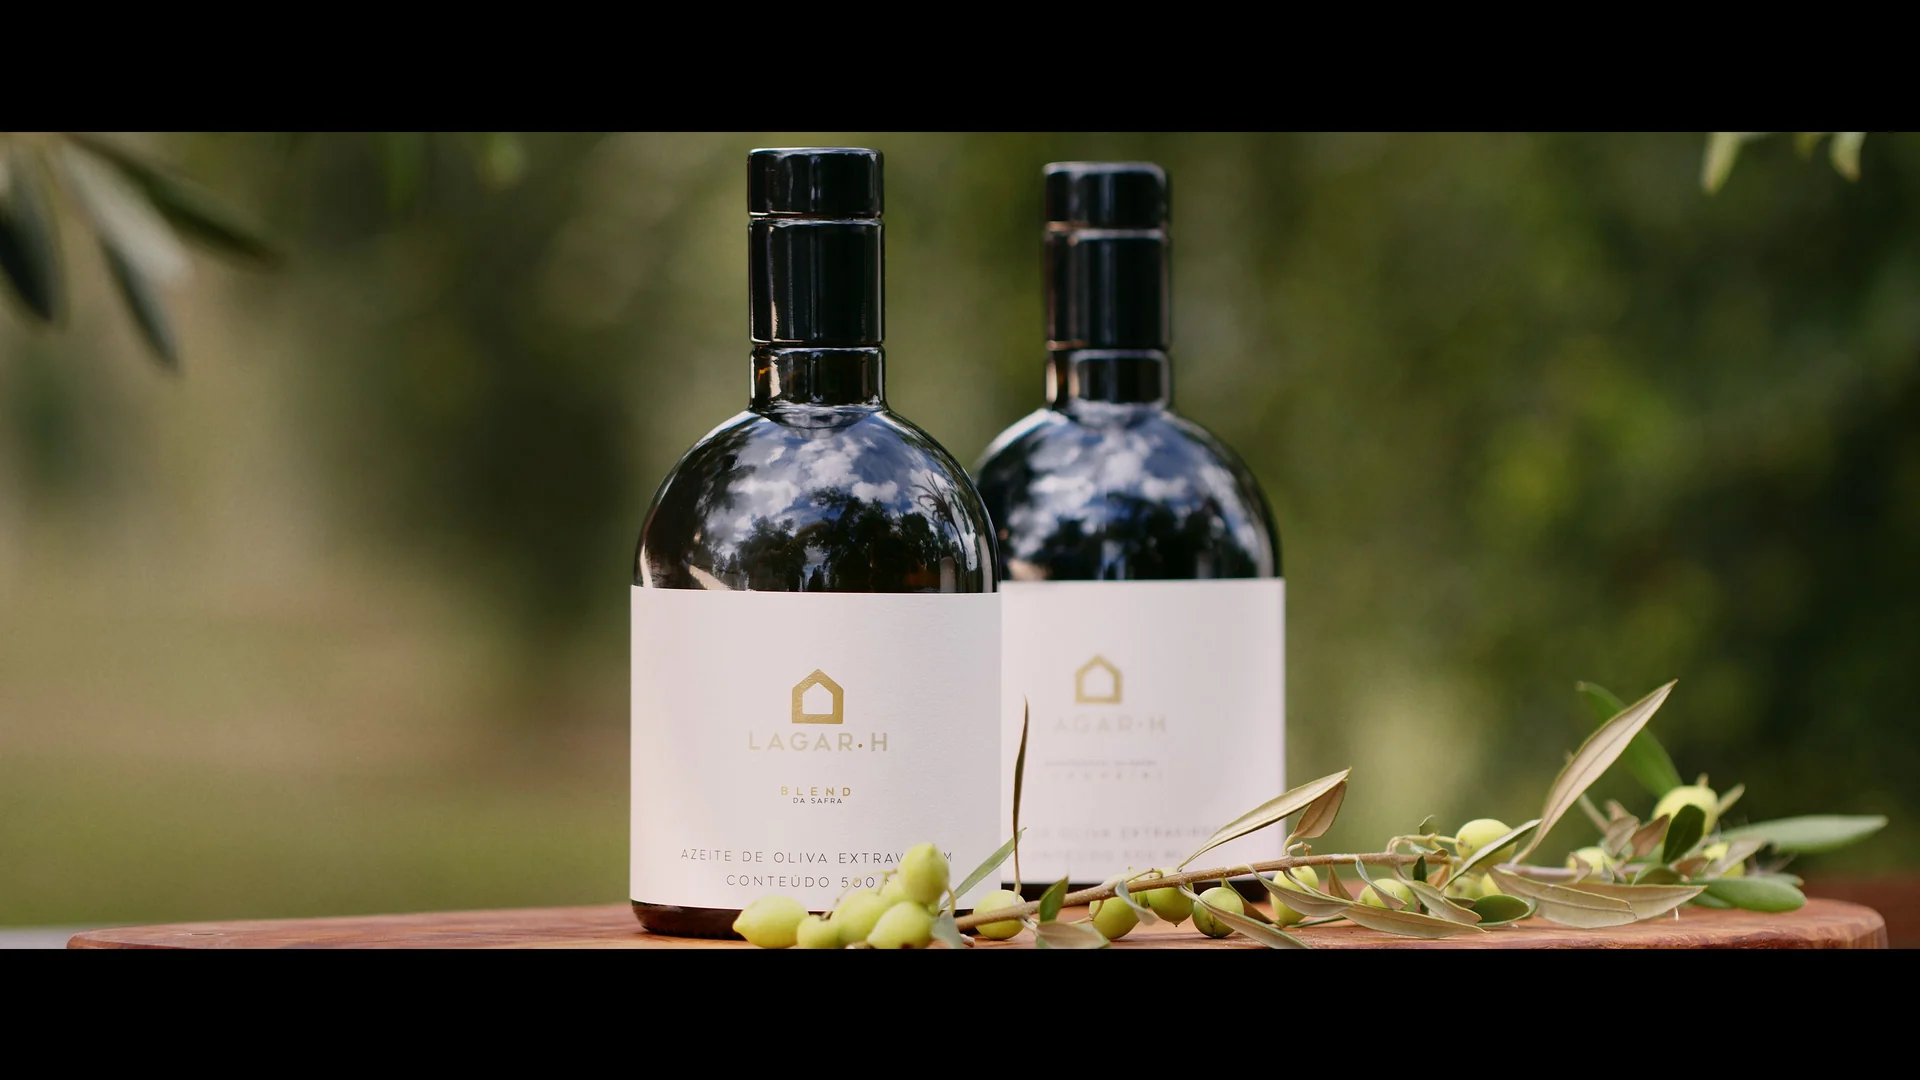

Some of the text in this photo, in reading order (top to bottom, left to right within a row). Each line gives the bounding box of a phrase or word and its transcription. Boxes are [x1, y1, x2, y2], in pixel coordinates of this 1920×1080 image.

[780, 785, 852, 797] BLEND
[810, 797, 843, 805] SAFRA
[680, 848, 732, 862] AZEITE
[742, 850, 763, 863] DE
[773, 851, 828, 864] OLIVA
[726, 874, 830, 889] CONTEÚDO
[841, 876, 875, 888] 500
